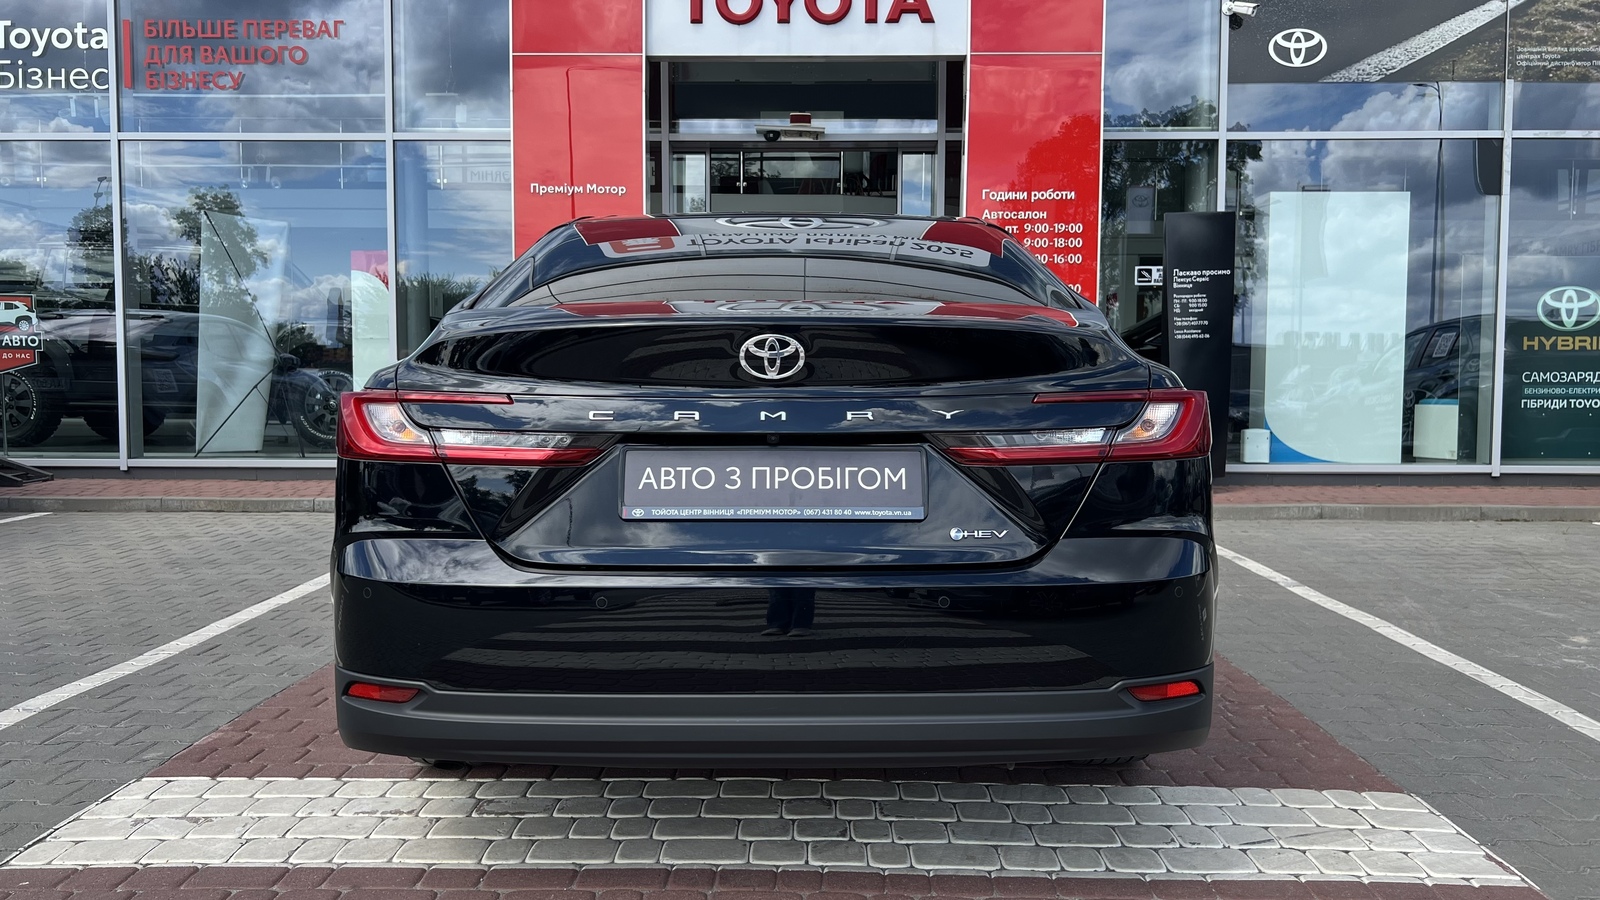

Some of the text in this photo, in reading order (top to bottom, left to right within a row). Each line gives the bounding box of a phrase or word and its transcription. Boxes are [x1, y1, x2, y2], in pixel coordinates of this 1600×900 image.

[144, 20, 344, 38] БІЛЬШЕ ПЕРЕВАГ
[0, 20, 108, 57] Toyota
[143, 45, 308, 67] ДЛЯ ВАШОГО
[0, 59, 109, 90] Бізнес
[145, 71, 244, 90] БІЗНЕСУ
[530, 183, 627, 196] Преміум Мотор
[982, 188, 1075, 202] Години роботи
[982, 209, 1047, 219] Автосалон
[1023, 223, 1083, 233] 9:00-19:00
[1023, 237, 1083, 248] 9:00-18:00
[1202, 269, 1231, 277] просимо
[2, 335, 39, 347] АВТО
[1523, 336, 1600, 351] HYBRI
[1521, 399, 1567, 410] ГІБРИДИ
[588, 409, 965, 421] CAMRY
[638, 466, 907, 490] АВТО З ПРОБІГОМ
[651, 508, 679, 516] ТОЙОТА
[680, 509, 702, 517] ЦЕНТР
[703, 509, 734, 517] ВІННИЦЯ
[854, 509, 912, 517] www.toyota.vn.ua
